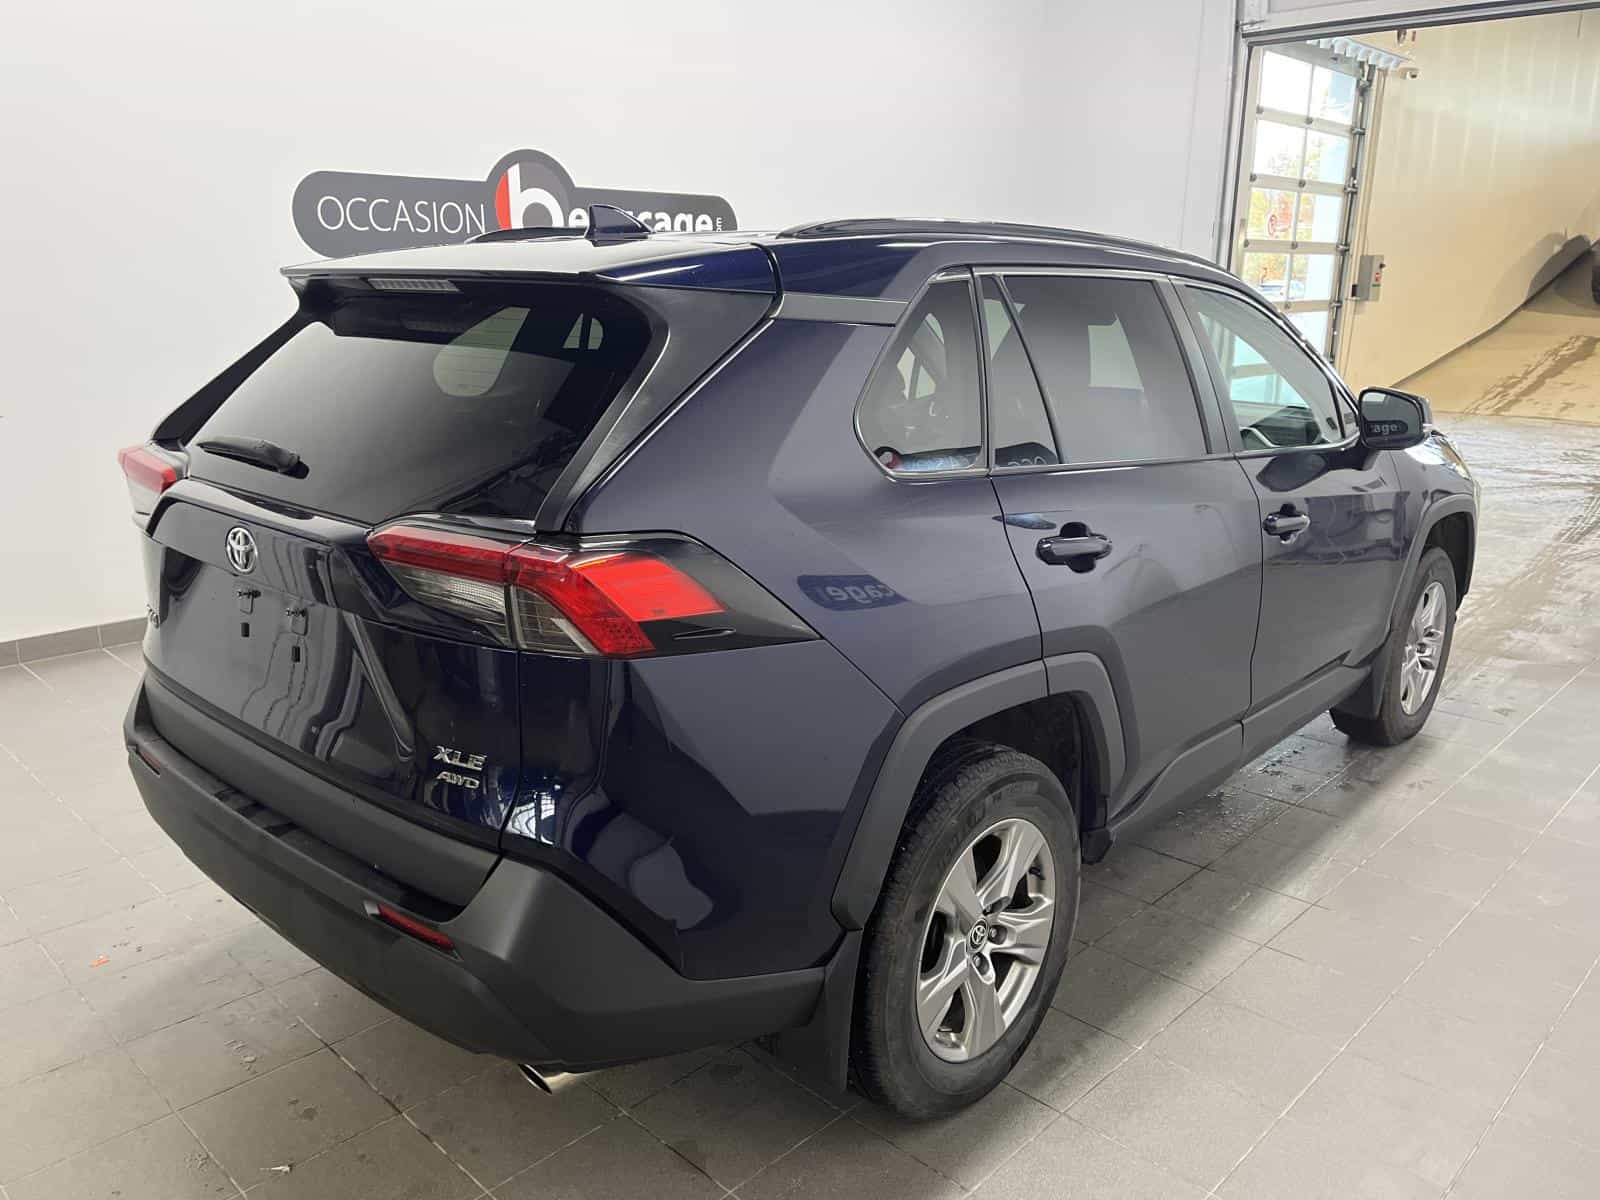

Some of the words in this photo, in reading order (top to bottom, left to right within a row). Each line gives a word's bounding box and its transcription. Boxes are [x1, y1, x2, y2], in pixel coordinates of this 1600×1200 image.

[317, 195, 486, 234] OCCASION
[433, 745, 487, 771] XLE
[436, 771, 480, 789] AWD
